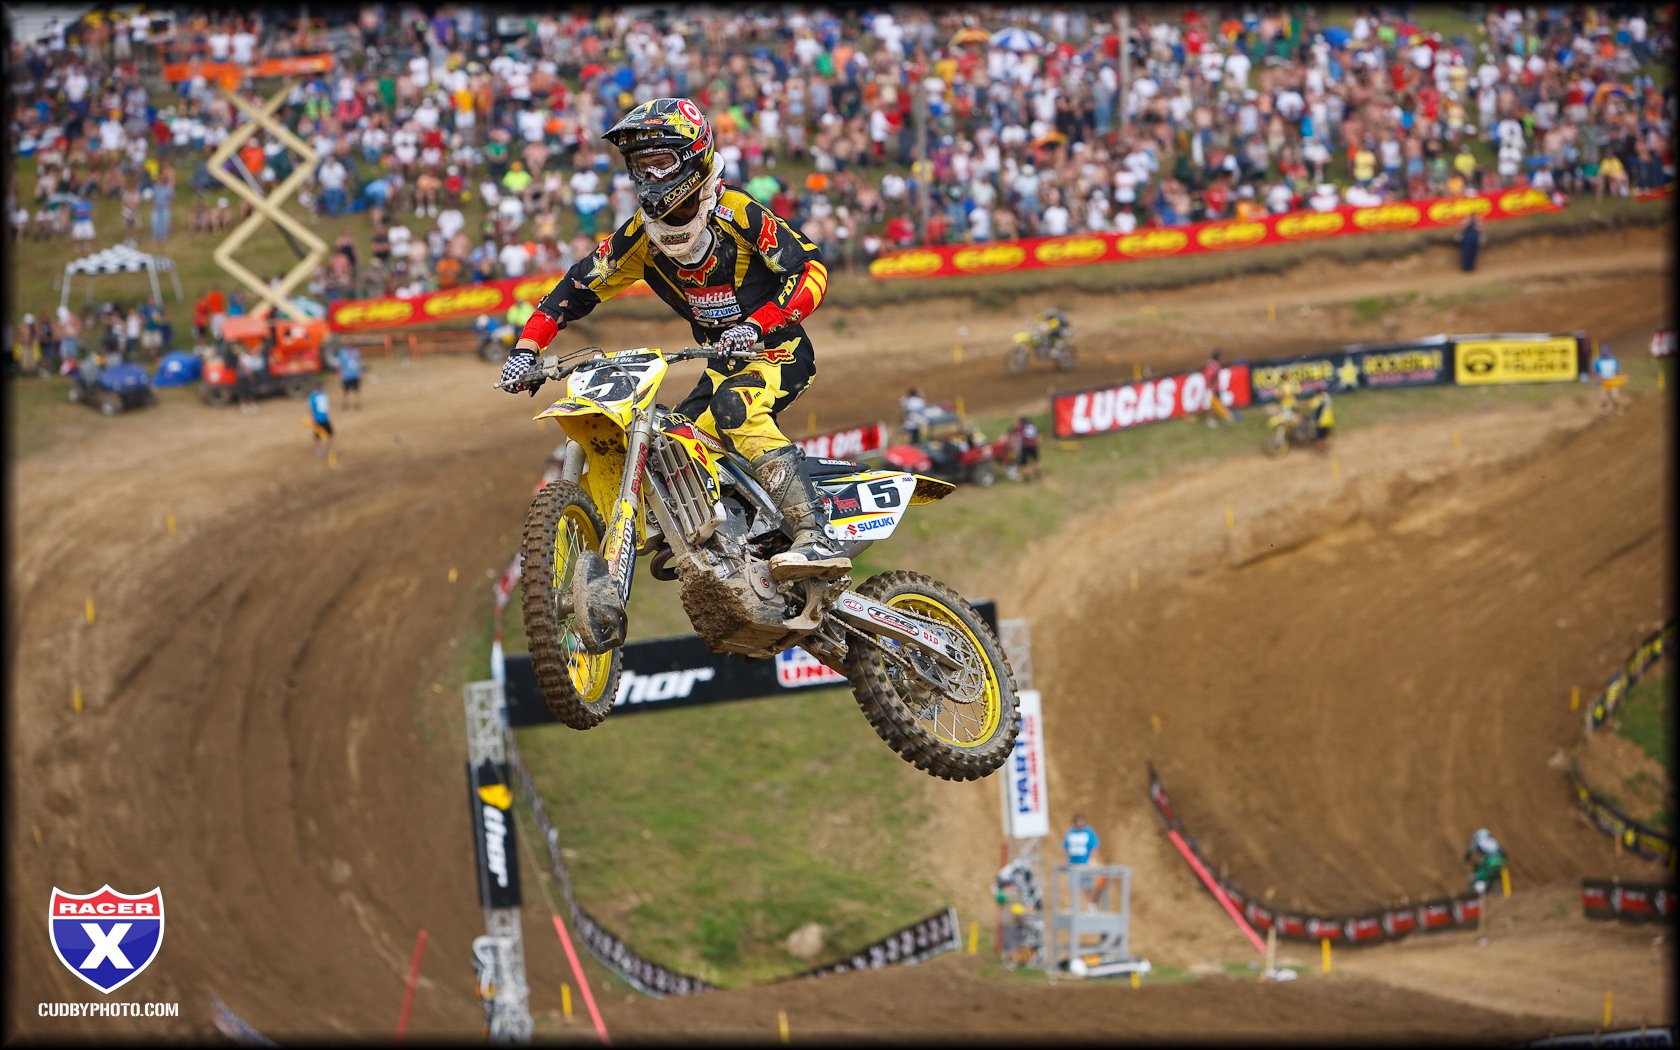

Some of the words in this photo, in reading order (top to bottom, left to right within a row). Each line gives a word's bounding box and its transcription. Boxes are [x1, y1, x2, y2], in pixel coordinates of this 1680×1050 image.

[685, 291, 736, 305] makita
[701, 305, 741, 317] SUZUKI
[581, 365, 650, 402] 5
[1071, 376, 1177, 434] LUCAS
[867, 479, 901, 508] 5
[857, 516, 895, 532] SUZUKI
[618, 518, 633, 586] DUNLOP
[614, 667, 716, 706] hor
